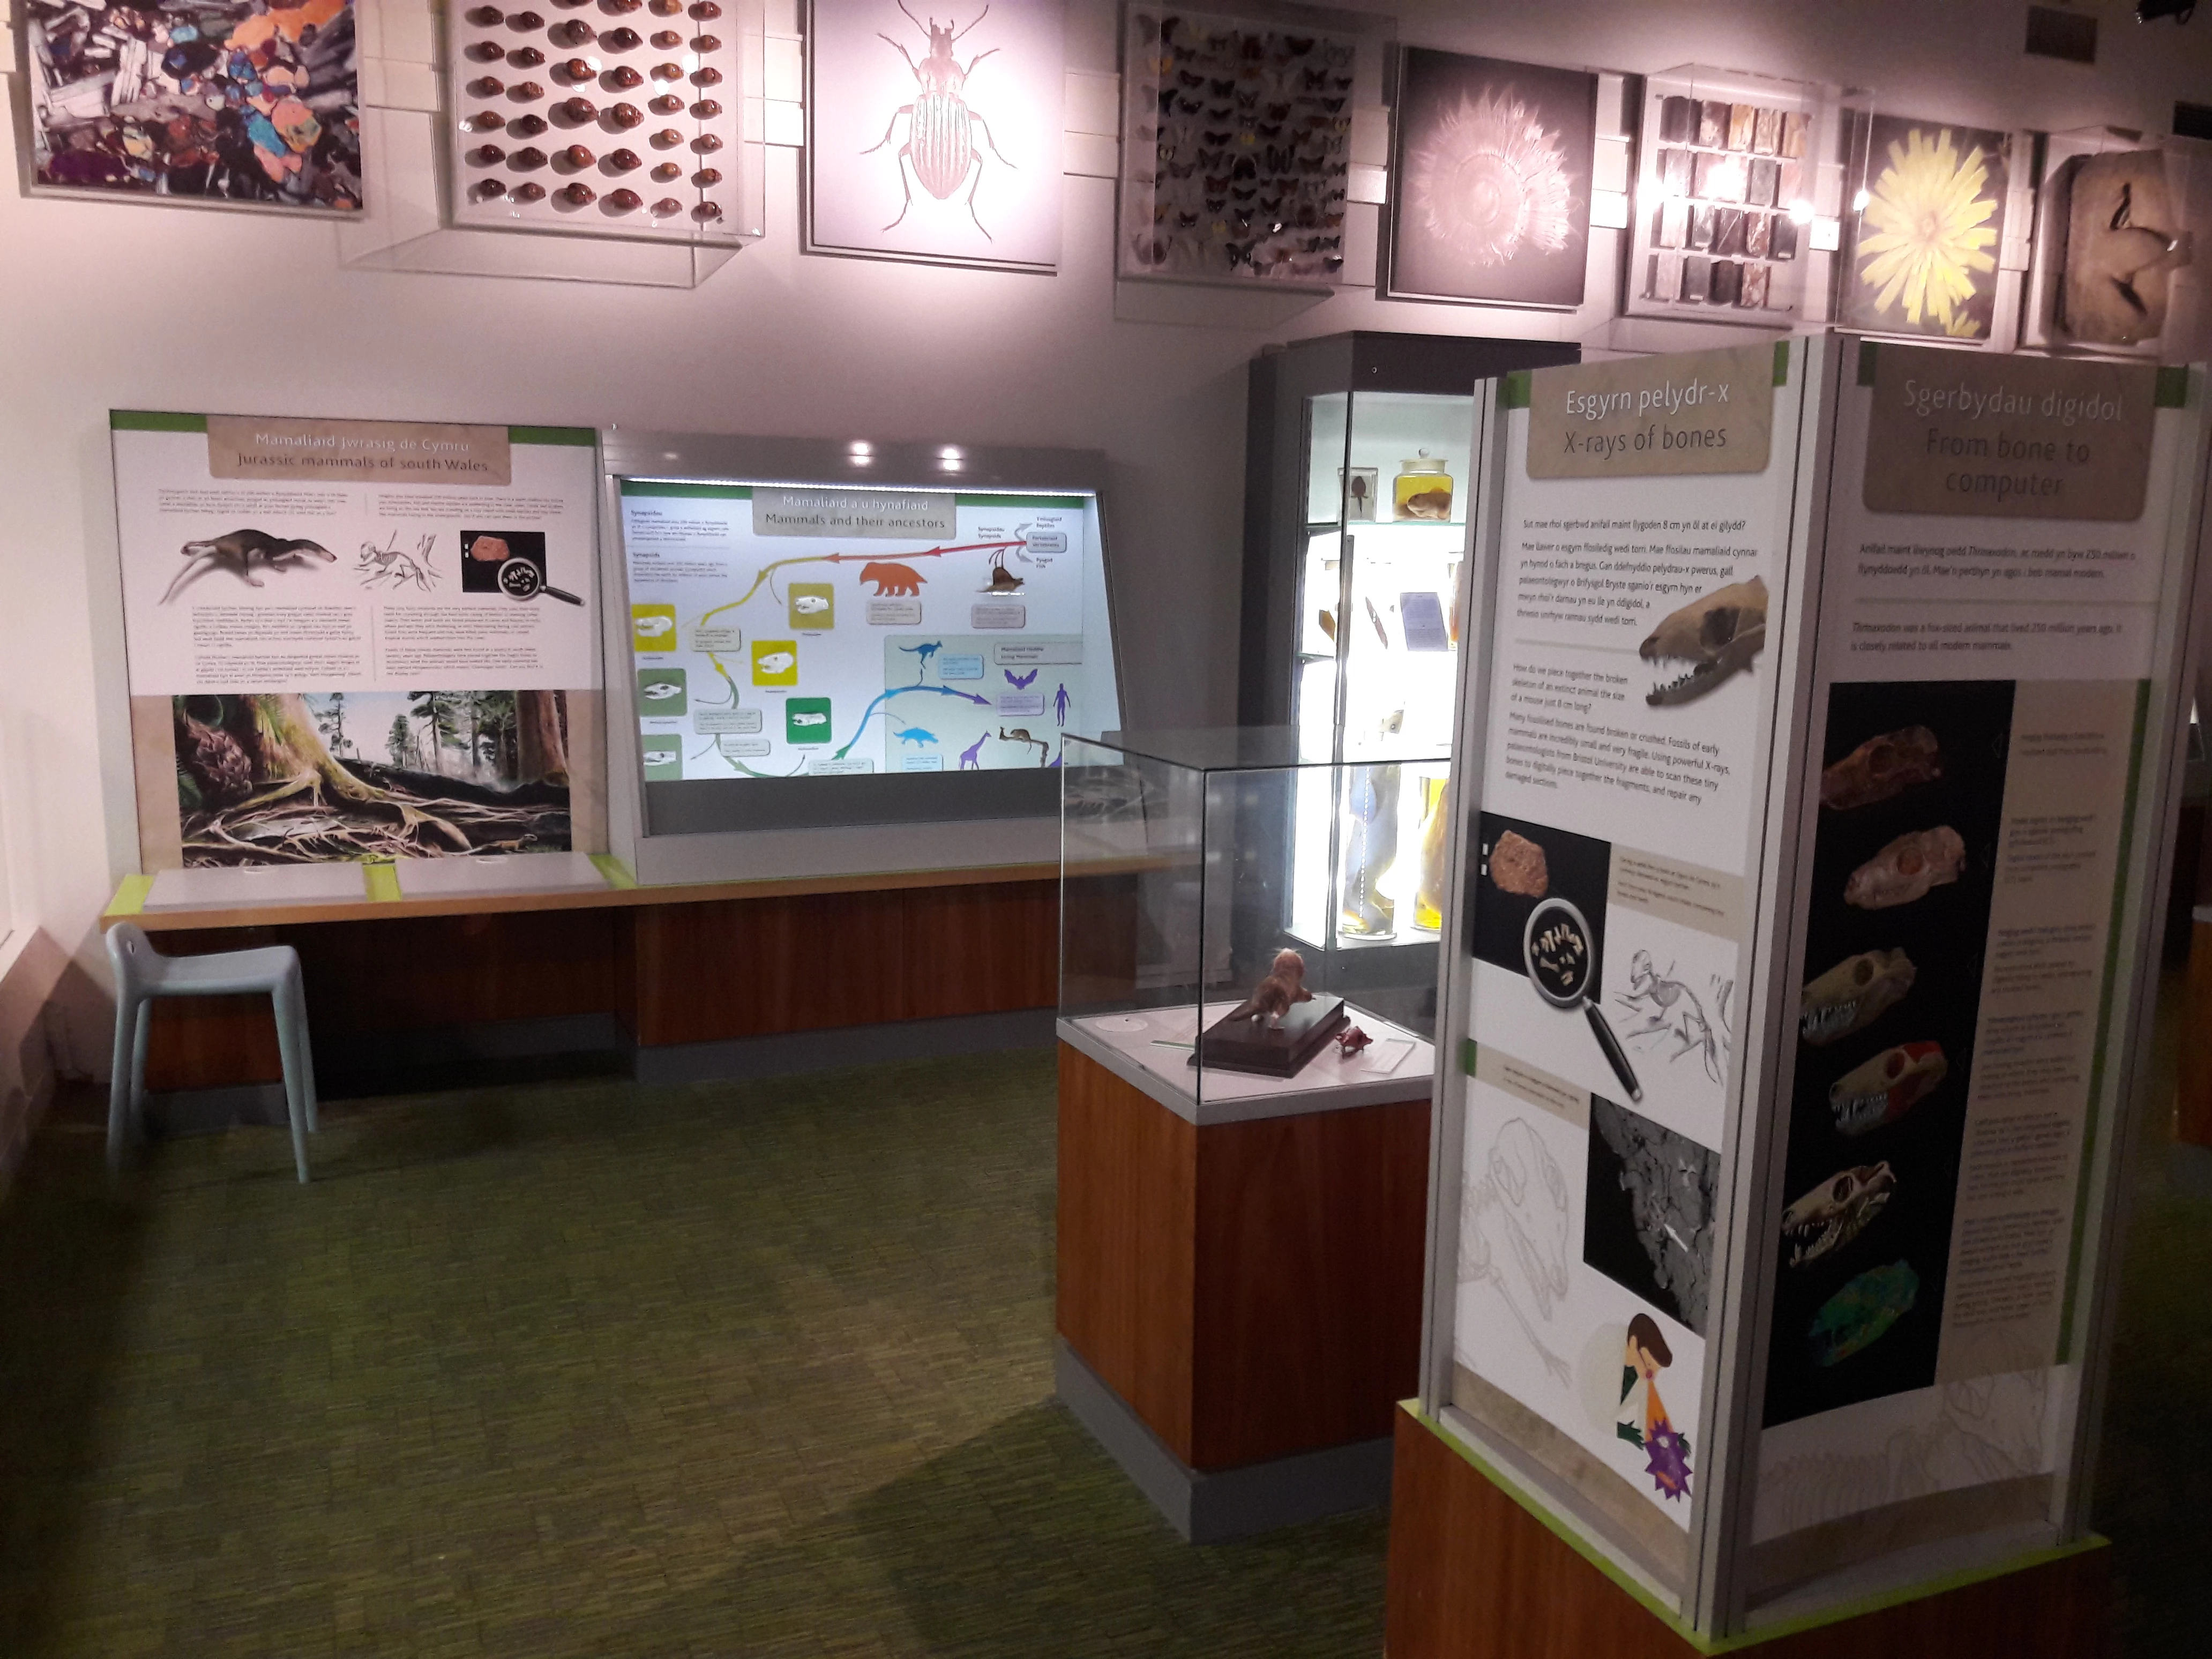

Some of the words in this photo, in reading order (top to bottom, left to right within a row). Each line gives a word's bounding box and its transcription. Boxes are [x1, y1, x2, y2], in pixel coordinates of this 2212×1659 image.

[1566, 390, 1631, 421] Esgyrn
[1639, 377, 1729, 418] pelydr-x
[1903, 380, 2033, 420] Sgerbydau
[2041, 390, 2122, 426] digidol
[256, 433, 335, 447] Mamaliaid
[341, 436, 395, 452] Jwrasig
[400, 438, 416, 450] de
[422, 439, 469, 454] Cymru
[1564, 430, 1626, 461] X-rays
[1634, 424, 1655, 451] of
[1663, 424, 1726, 450] bones
[1926, 428, 1988, 457] From
[1998, 431, 2056, 461] bone
[2066, 439, 2090, 462] to
[238, 453, 294, 467] Jurassic
[302, 456, 374, 468] mammals
[380, 457, 393, 468] of
[400, 457, 440, 470] south
[445, 459, 488, 473] Wales
[1946, 472, 2064, 503] computer
[783, 496, 847, 509] Mamaliaid
[872, 498, 929, 512] hynafiaid
[766, 514, 825, 525] Mammals
[830, 515, 851, 526] and
[856, 515, 883, 526] their
[888, 518, 945, 528] ancestors
[1612, 520, 1631, 529] maint
[1633, 519, 1661, 532] llygoden
[1663, 520, 1668, 529] 8
[1682, 522, 1690, 533] yn
[1719, 520, 1746, 533] gilydd?
[1615, 543, 1630, 553] wedi
[1649, 545, 1663, 554] Mae
[1693, 546, 1730, 556] mamaliaid
[1732, 549, 1758, 559] cynnar
[1680, 582, 1692, 595] hyn
[1695, 585, 1702, 593] er
[1606, 600, 1614, 608] yn
[1692, 741, 1700, 751] of
[1702, 743, 1719, 757] early
[1705, 779, 1719, 791] tiny
